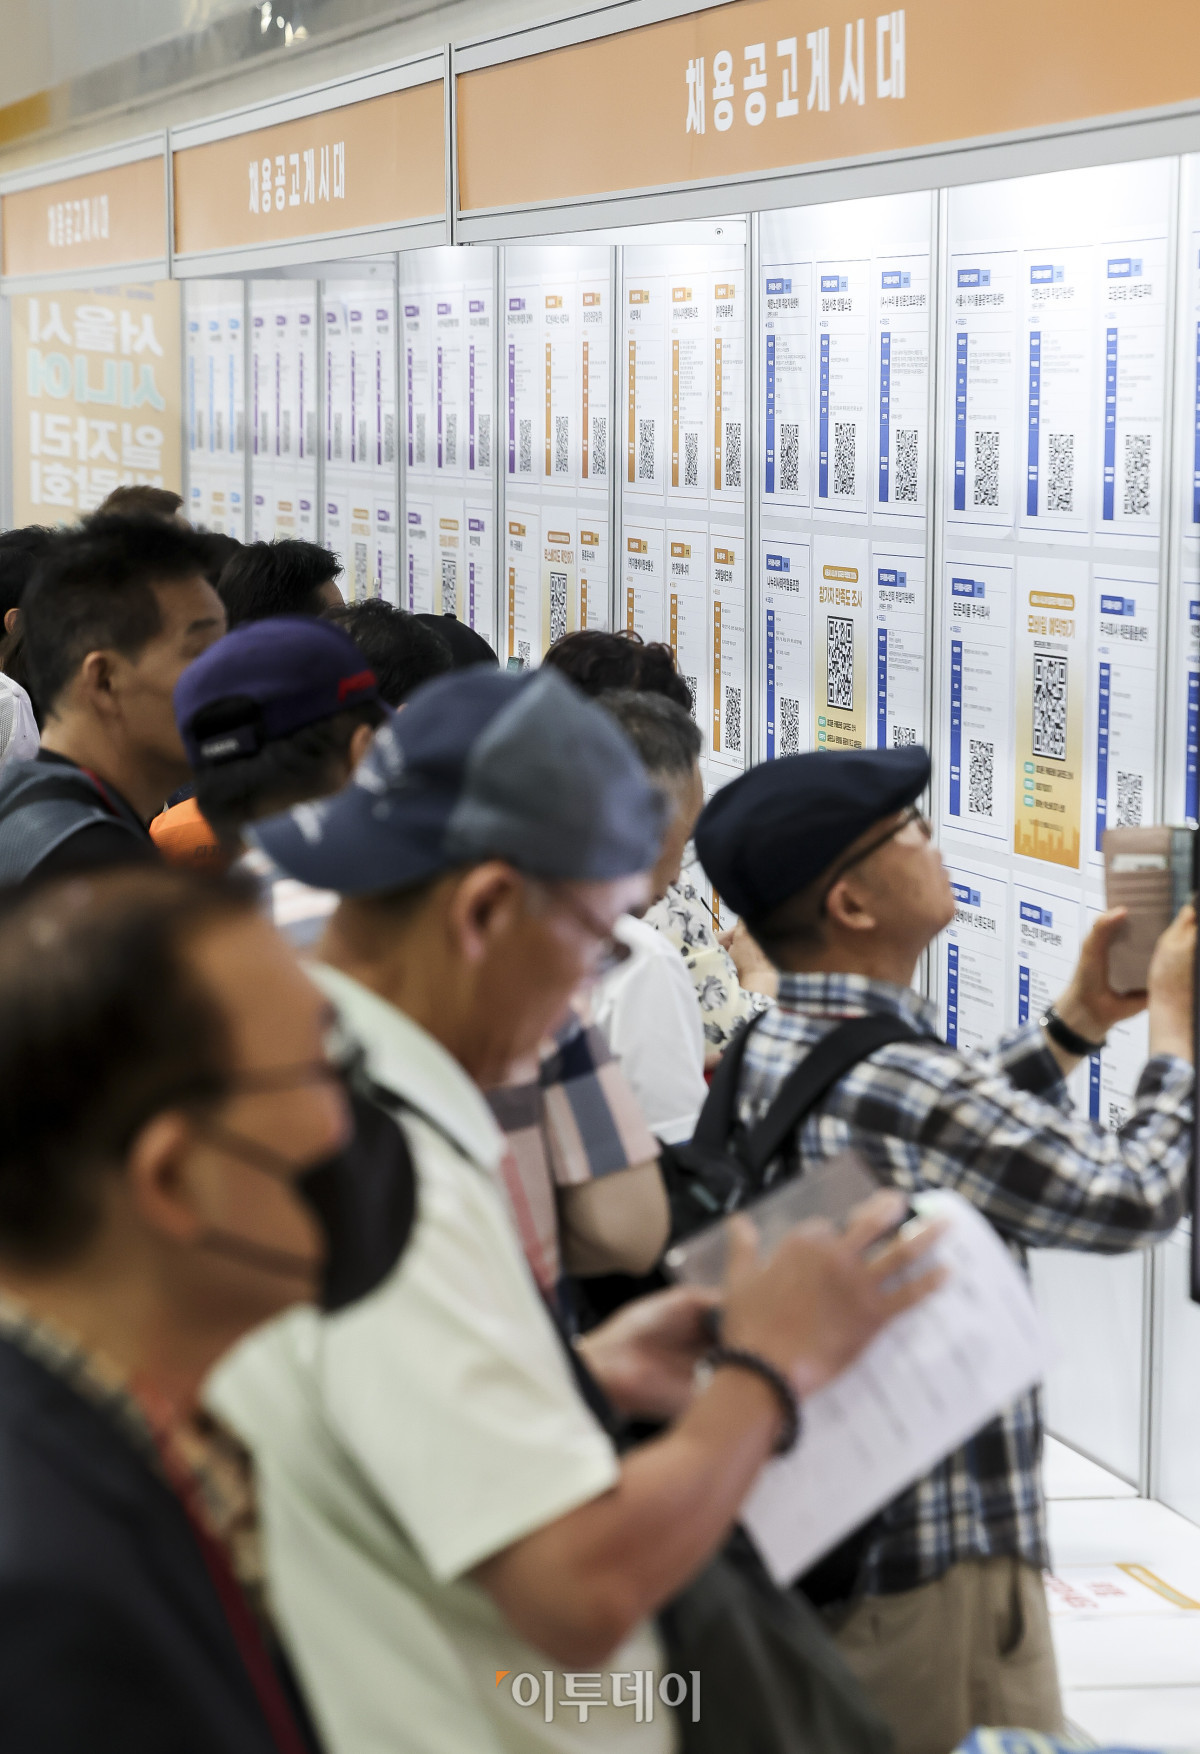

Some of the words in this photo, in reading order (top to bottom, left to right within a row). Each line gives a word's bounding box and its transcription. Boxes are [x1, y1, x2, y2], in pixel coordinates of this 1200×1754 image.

[686, 9, 905, 134] 채용공고게시대
[249, 141, 345, 214] 채용공고게시대
[819, 585, 834, 605] 참가자
[835, 587, 850, 607] 만족도
[852, 589, 863, 608] 조사
